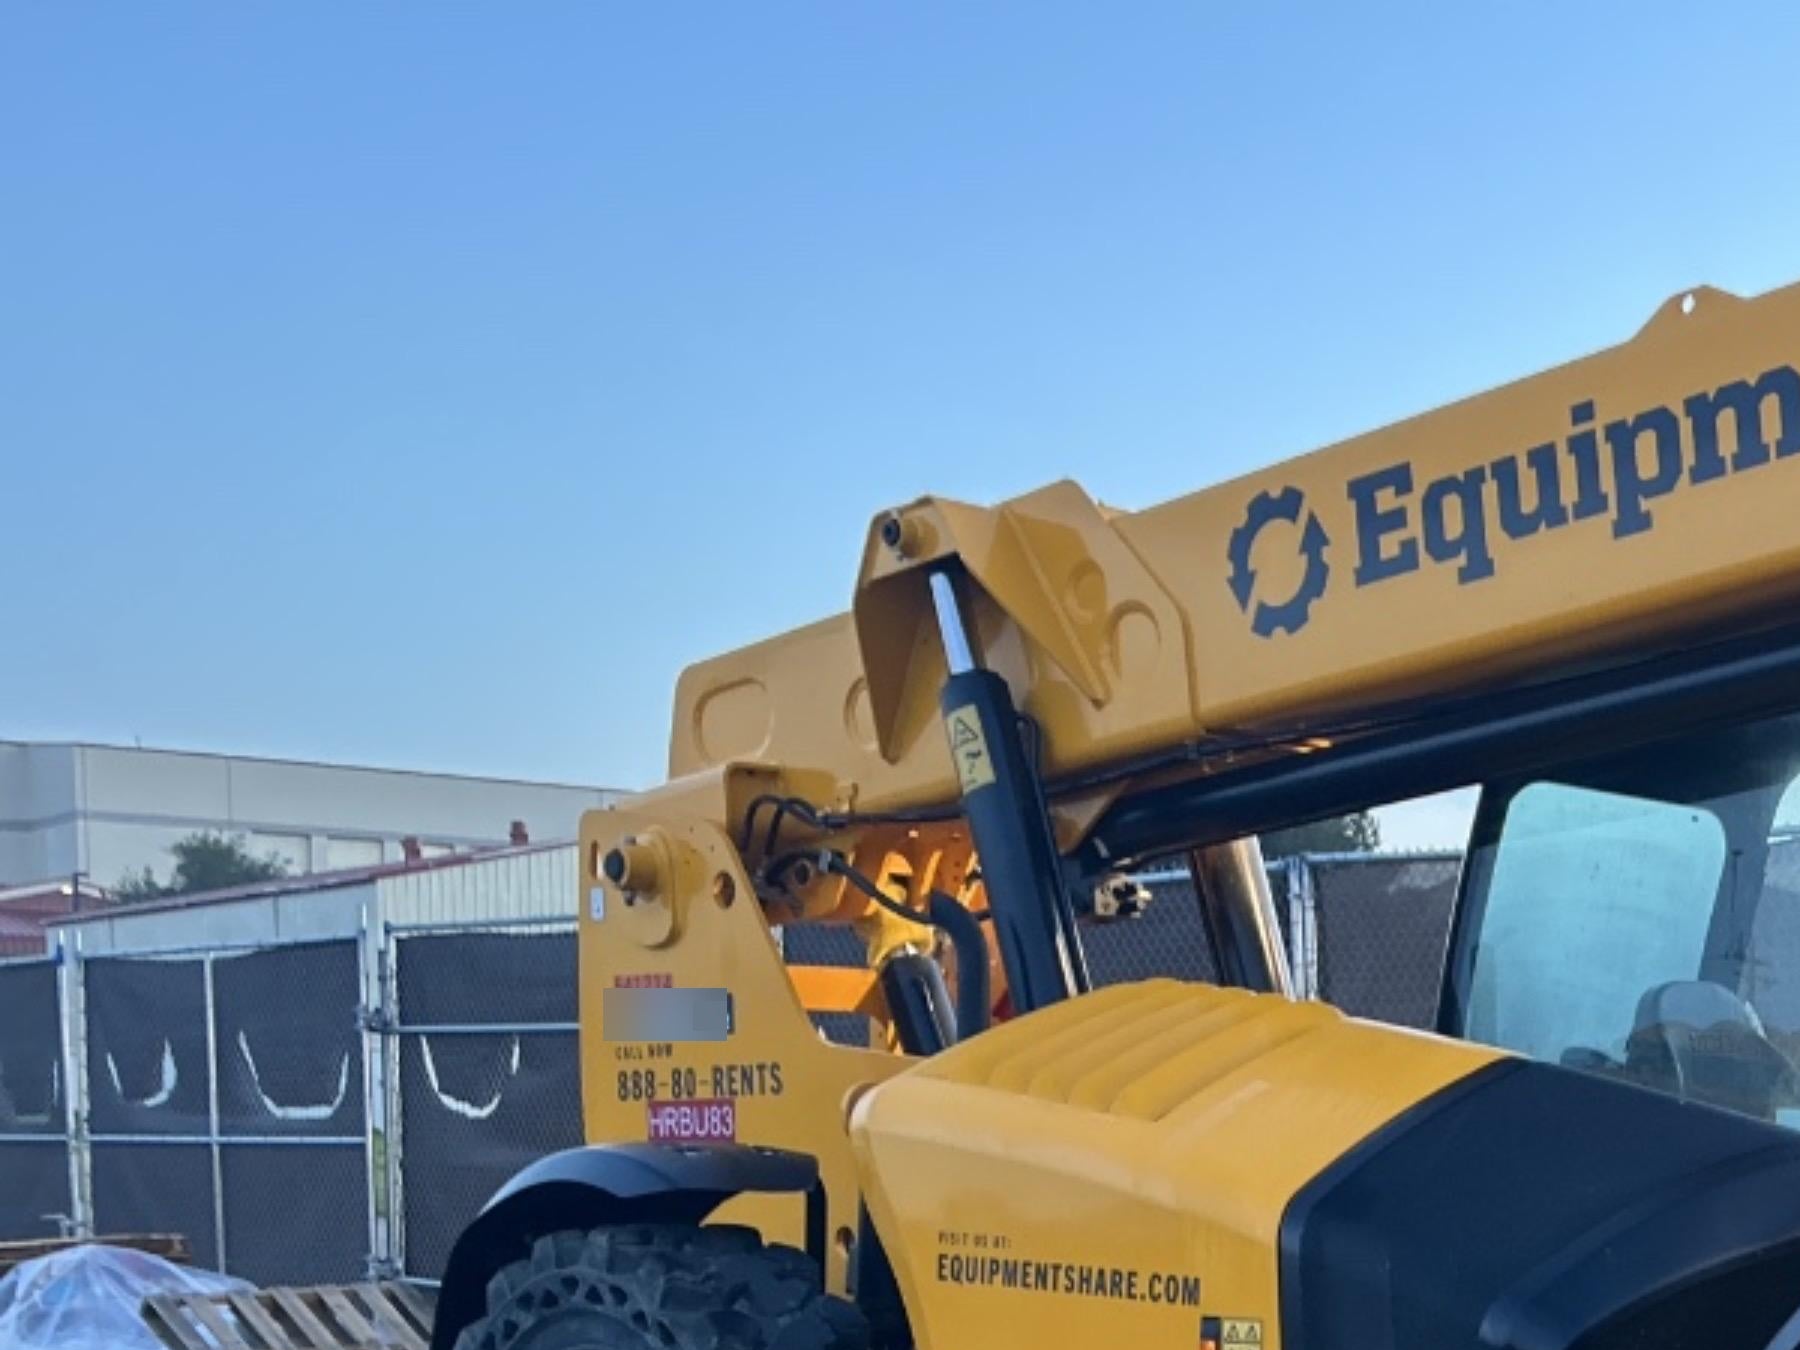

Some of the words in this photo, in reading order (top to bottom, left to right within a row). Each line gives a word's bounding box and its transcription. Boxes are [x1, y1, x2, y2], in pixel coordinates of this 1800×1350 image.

[615, 1046, 643, 1060] CALL
[648, 1043, 672, 1058] NOW
[617, 1062, 783, 1101] 888-80-RENTS
[650, 1105, 733, 1138] HRBU83
[938, 1231, 968, 1246] VISIT
[974, 1233, 988, 1248] US
[937, 1253, 1200, 1306] EQUIPMENTSHARE.COM
